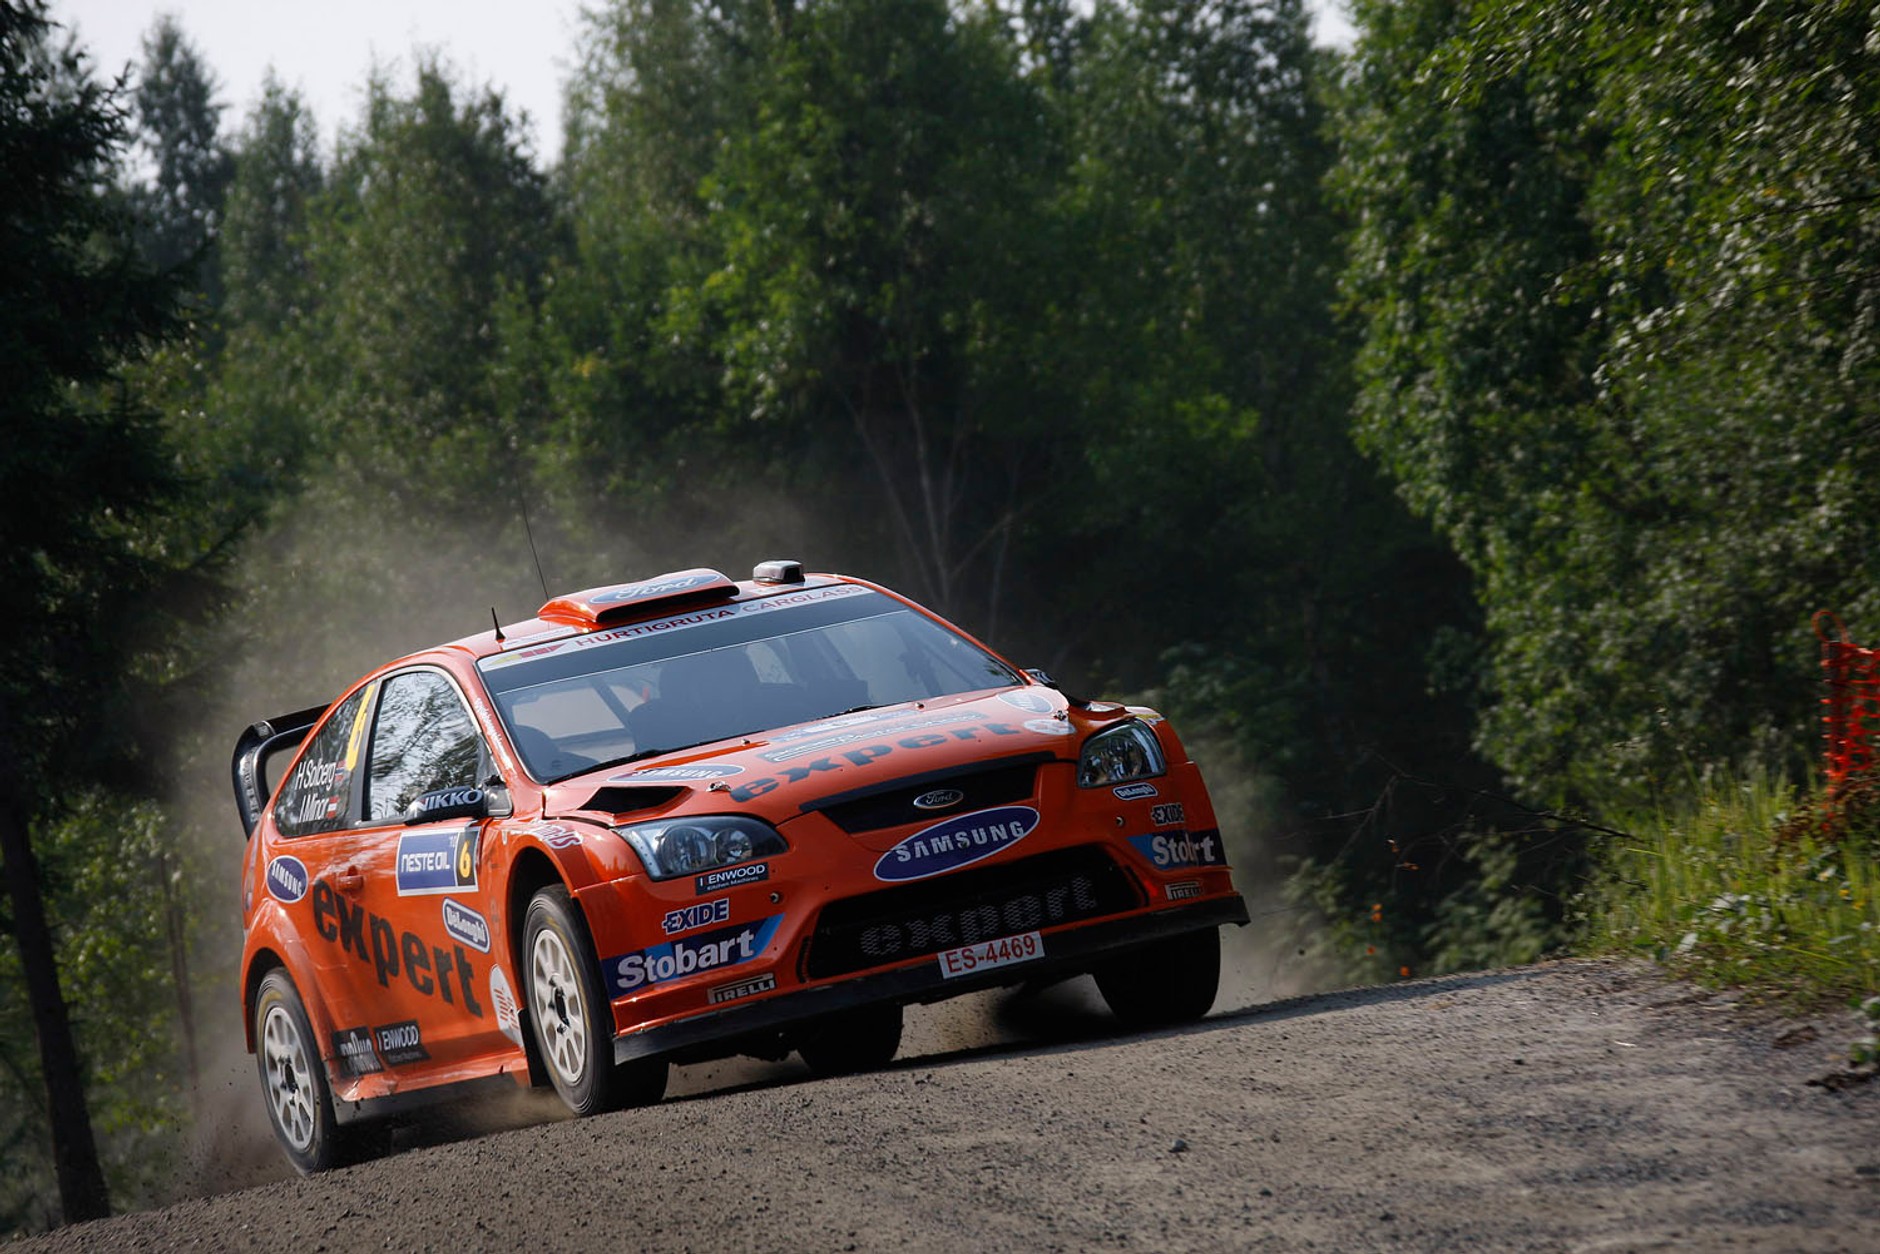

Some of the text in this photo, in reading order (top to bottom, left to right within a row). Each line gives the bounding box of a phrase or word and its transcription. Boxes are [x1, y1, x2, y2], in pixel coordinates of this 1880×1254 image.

[615, 577, 697, 600] Ford
[576, 609, 736, 648] HURTIGRUTA
[742, 585, 864, 613] CARGLASS
[294, 761, 307, 791] H
[303, 757, 337, 792] Solberg
[729, 722, 1024, 803] expert
[925, 791, 954, 805] Ford
[459, 839, 472, 878] 6
[895, 820, 1025, 863] SAMSUNG
[271, 860, 302, 897] SAMSUNG
[662, 898, 730, 935] EXIDE
[859, 875, 1099, 957] expert
[313, 878, 483, 1018] expert
[616, 928, 755, 988] Stobart
[945, 934, 1037, 974] ES-4469
[707, 972, 776, 1005] PIRELLI
